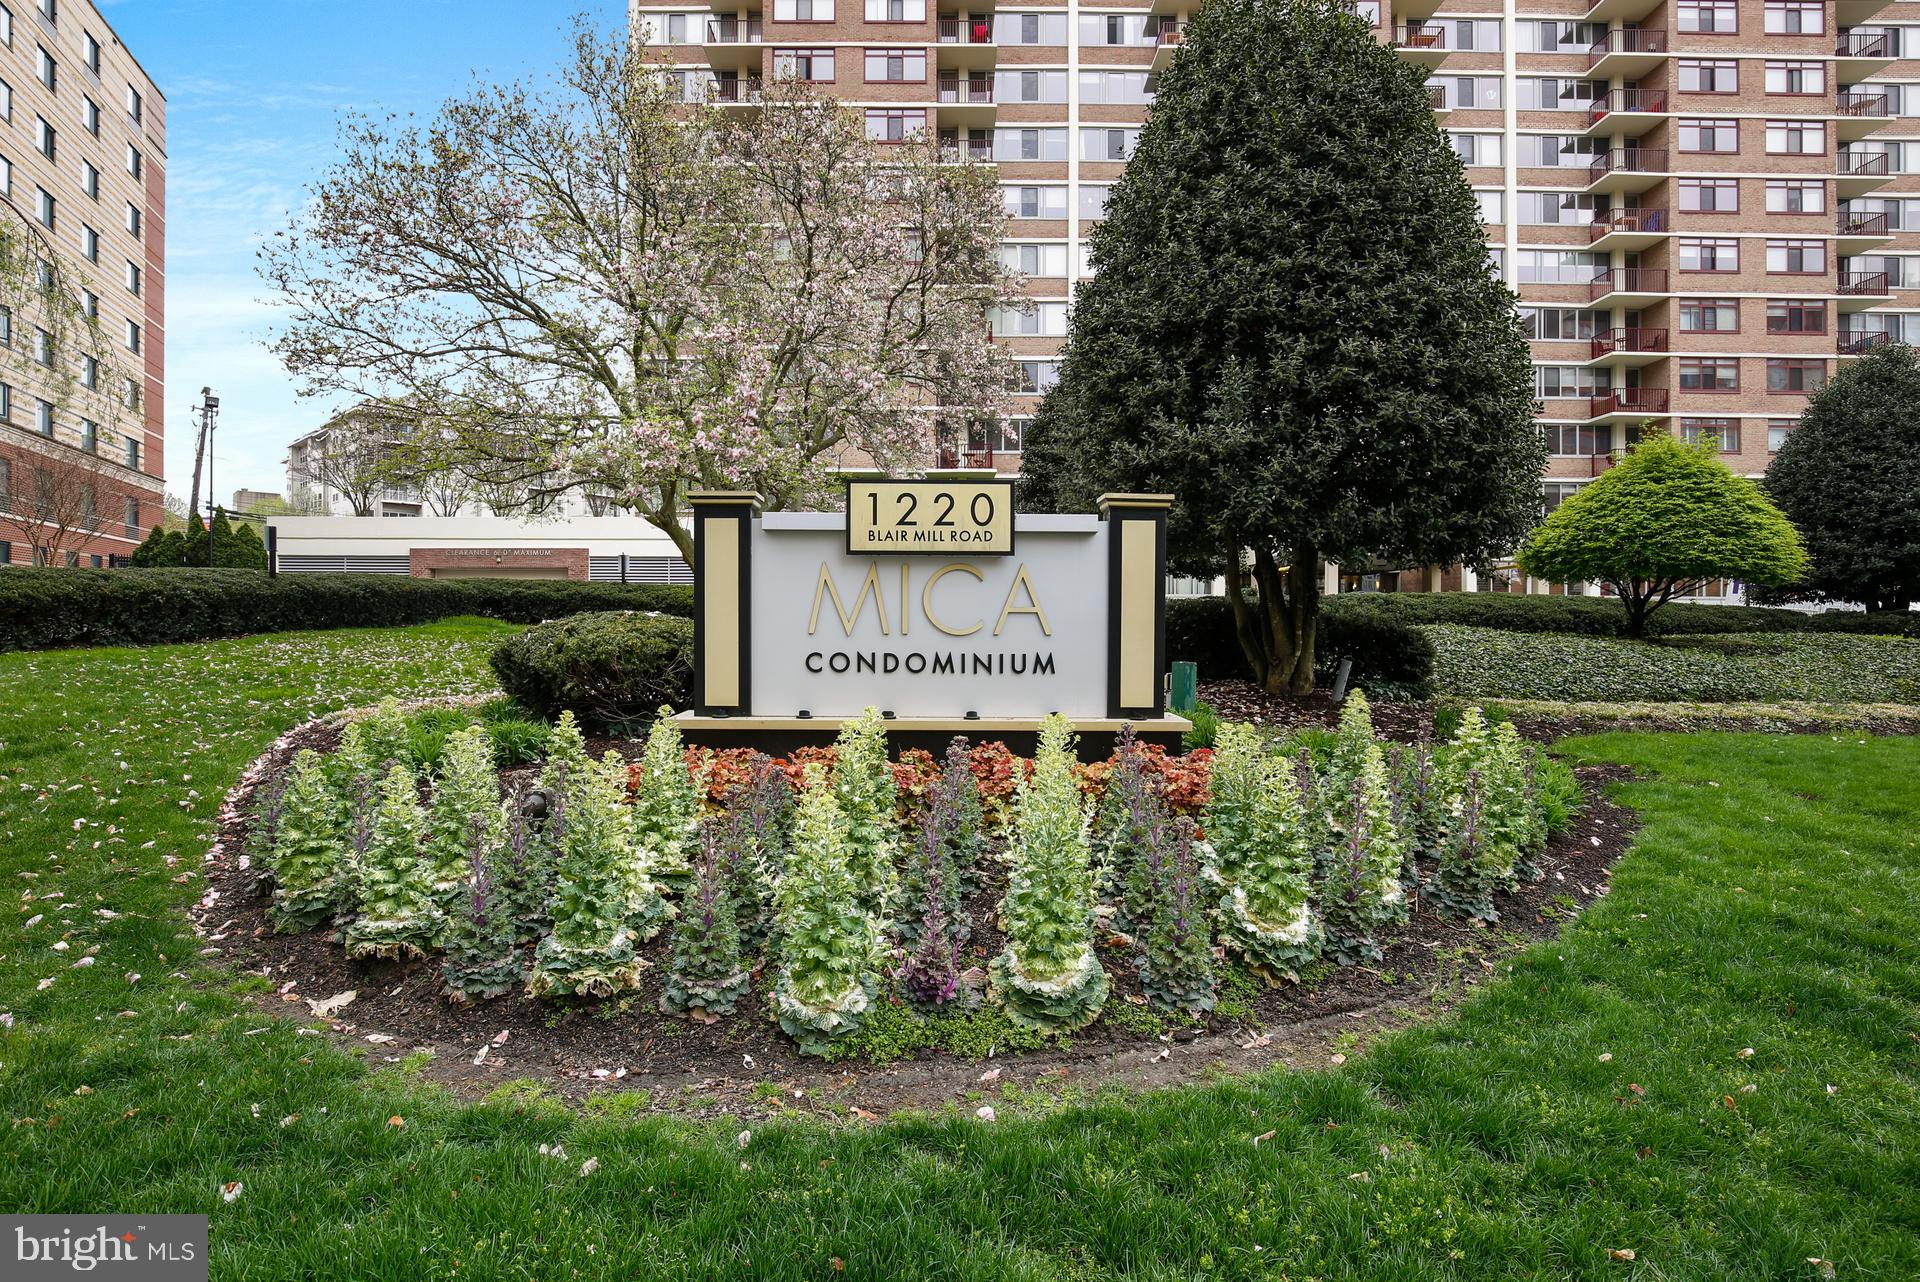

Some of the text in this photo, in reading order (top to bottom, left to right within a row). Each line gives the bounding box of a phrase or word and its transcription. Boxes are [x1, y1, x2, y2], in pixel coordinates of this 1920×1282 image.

[867, 492, 995, 526] 1220
[868, 530, 993, 542] BLAIR MILL ROAD
[808, 560, 1052, 636] MICA
[805, 651, 1056, 675] CONDOMINIUM
